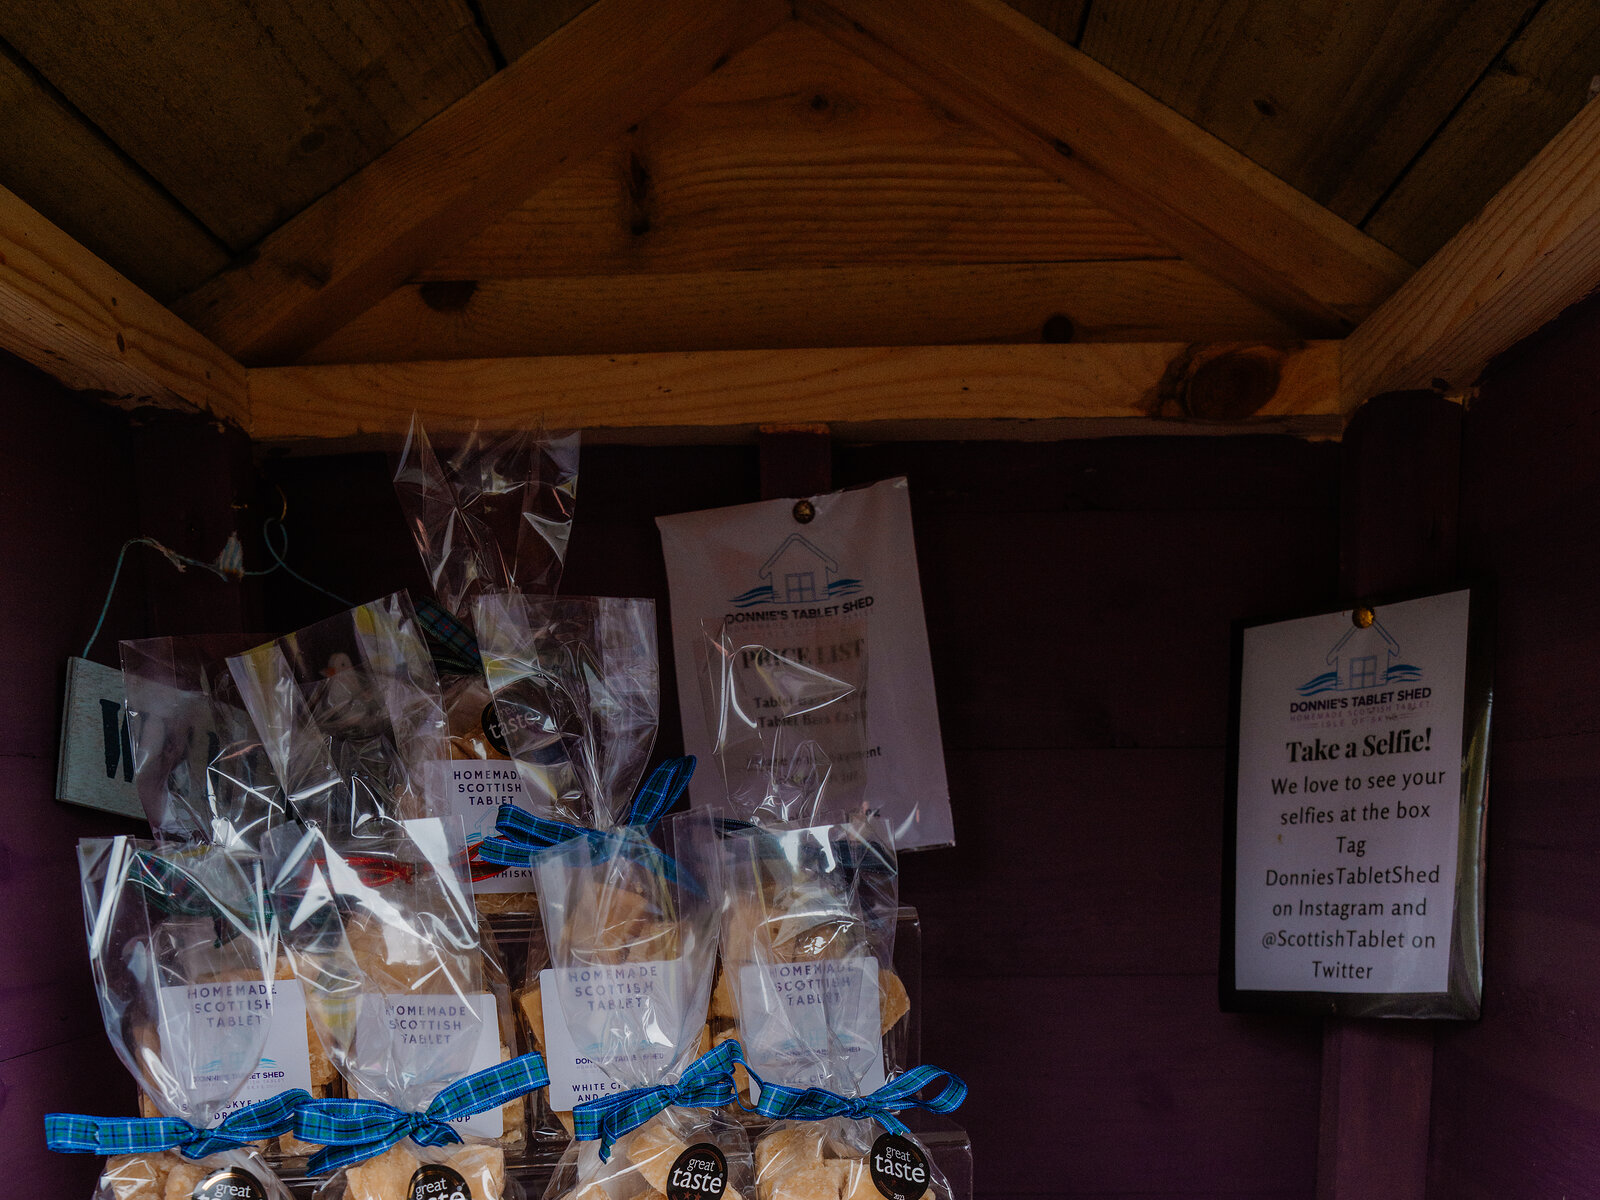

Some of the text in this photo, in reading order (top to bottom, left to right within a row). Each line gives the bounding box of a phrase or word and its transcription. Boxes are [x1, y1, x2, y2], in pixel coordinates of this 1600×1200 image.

[726, 596, 875, 625] DONNIE'S TABLET SHED
[1290, 687, 1432, 713] DONNIE'S TABLET SHED
[488, 711, 536, 740] taste
[1290, 712, 1342, 722] HOMEMADE
[1286, 727, 1432, 763] Take a Selfie!
[458, 783, 522, 793] SCOTTISH
[1271, 770, 1446, 796] We love to see your
[469, 795, 515, 806] TABLET
[1280, 800, 1431, 826] selfies at the box
[1336, 835, 1367, 858] Tag
[1265, 865, 1440, 887] DonniesTabletShed
[1272, 898, 1427, 921] on Instagram and
[1262, 930, 1436, 949] @ScottishTablet on
[568, 966, 658, 983] HOMEMADE
[1312, 961, 1373, 979] Twitter
[574, 981, 654, 998] SCOTTISH
[385, 1005, 466, 1016] HOMEMADE
[587, 997, 642, 1012] TABLET
[206, 1014, 262, 1028] TABLET
[389, 1020, 462, 1030] SCOTTISH
[263, 1071, 285, 1079] SHED
[572, 1082, 606, 1092] WHITE
[577, 1093, 599, 1102] AND
[886, 1146, 911, 1163] great
[688, 1158, 716, 1173] great
[874, 1153, 926, 1184] taste
[416, 1178, 448, 1199] great
[672, 1167, 723, 1194] taste
[215, 1182, 252, 1200] great
